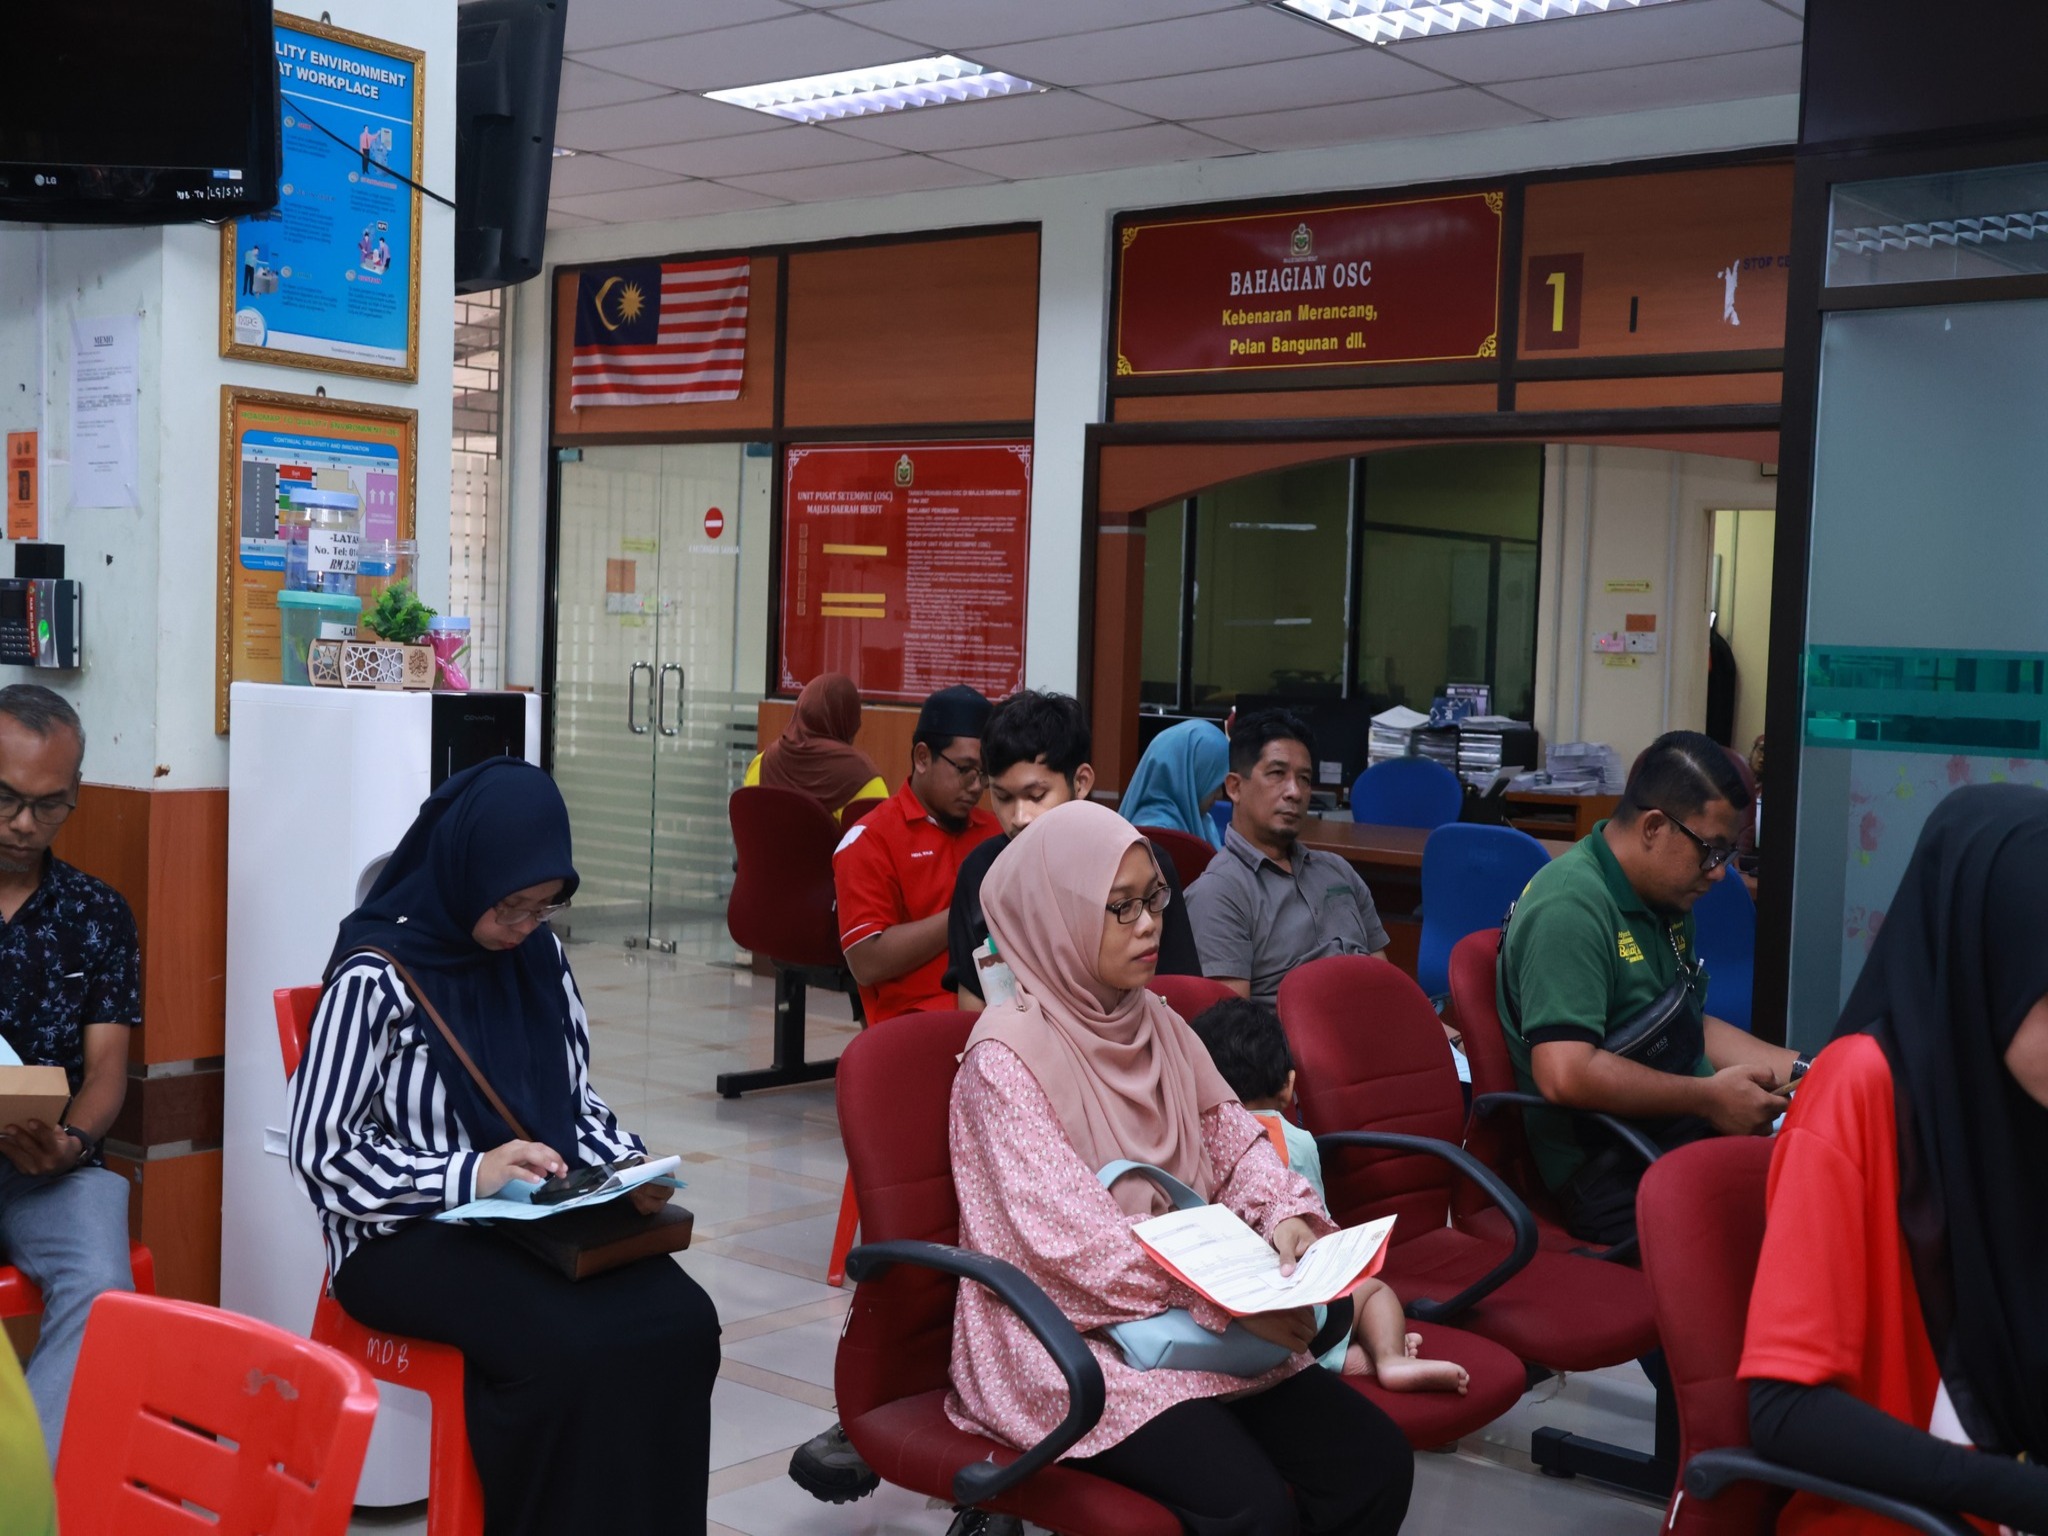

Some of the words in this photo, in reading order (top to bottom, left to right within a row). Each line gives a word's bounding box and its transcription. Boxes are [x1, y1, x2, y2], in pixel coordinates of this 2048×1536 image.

[275, 41, 307, 61] LITY
[310, 51, 407, 87] ENVIRONMENT
[296, 67, 379, 99] WORKPLACE
[1230, 264, 1326, 296] BAHAGIAN
[1333, 261, 1372, 288] OSC
[1546, 272, 1565, 332] 1
[1222, 309, 1292, 326] Kebenaran
[1298, 304, 1378, 321] Merancang,
[94, 336, 113, 344] MEMO
[1230, 338, 1265, 355] Pelan
[1272, 336, 1338, 355] Bangunan
[1346, 332, 1366, 349] dll.
[296, 417, 328, 427] QUALITY
[330, 420, 382, 433] ENVIRONMENT
[273, 436, 300, 445] CONTINUAL
[302, 439, 330, 448] CREATIVITY
[342, 443, 369, 452] INNOVATION
[798, 491, 814, 500] UNIT
[815, 491, 836, 500] PUSAT
[838, 491, 872, 500] SETEMPAT
[807, 505, 830, 515] MAJLIS
[831, 505, 859, 514] DAERAH
[315, 546, 329, 555] No.
[333, 547, 347, 556] Tel:
[329, 559, 344, 570] RM
[367, 1337, 409, 1373] MDB
